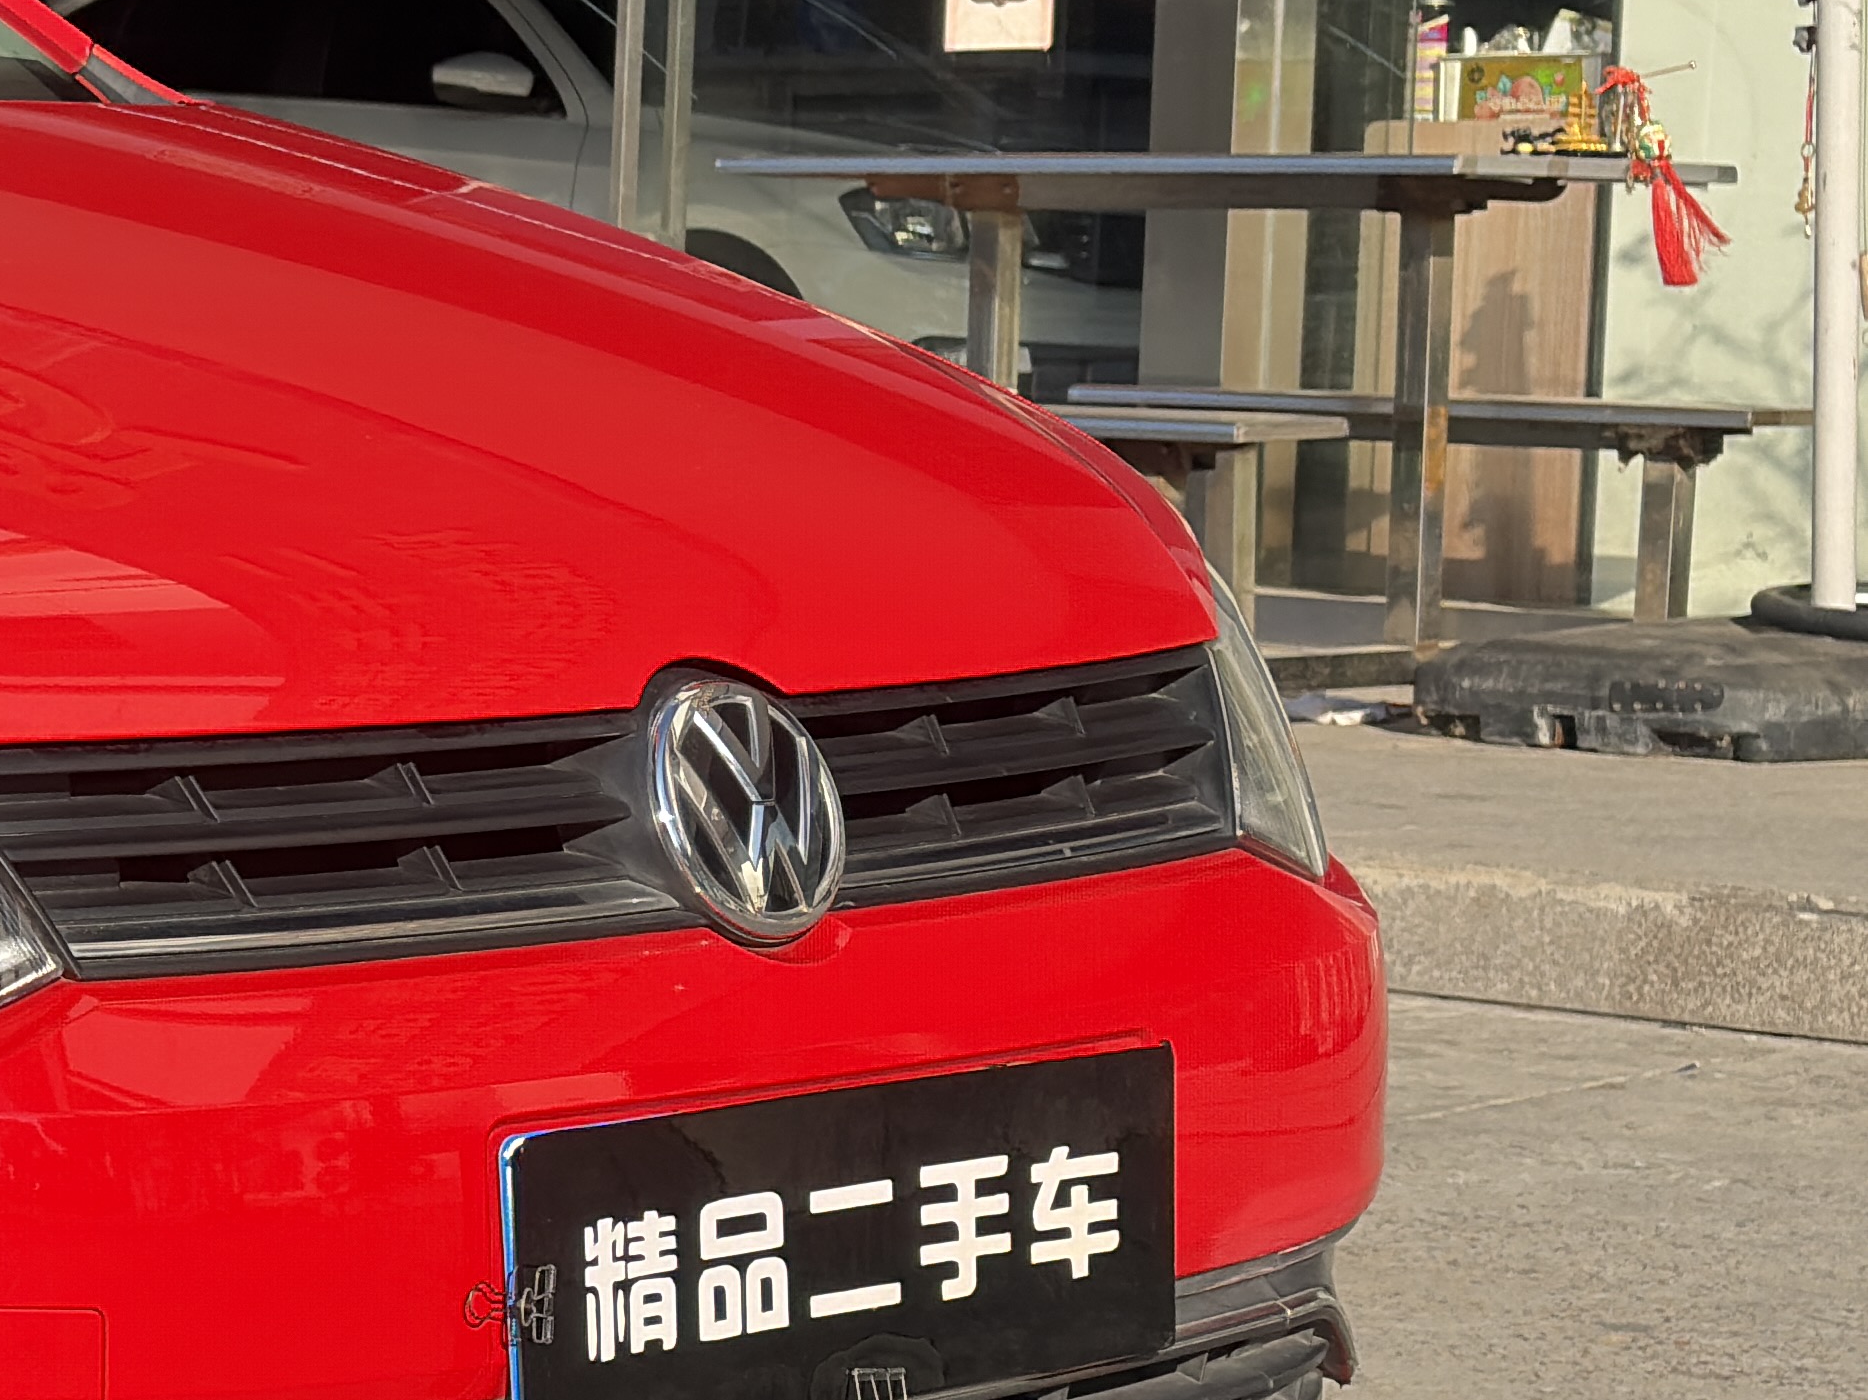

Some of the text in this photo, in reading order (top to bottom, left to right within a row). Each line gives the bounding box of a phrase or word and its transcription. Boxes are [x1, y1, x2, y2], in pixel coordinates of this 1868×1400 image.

[582, 1145, 1121, 1364] 精品二手车
